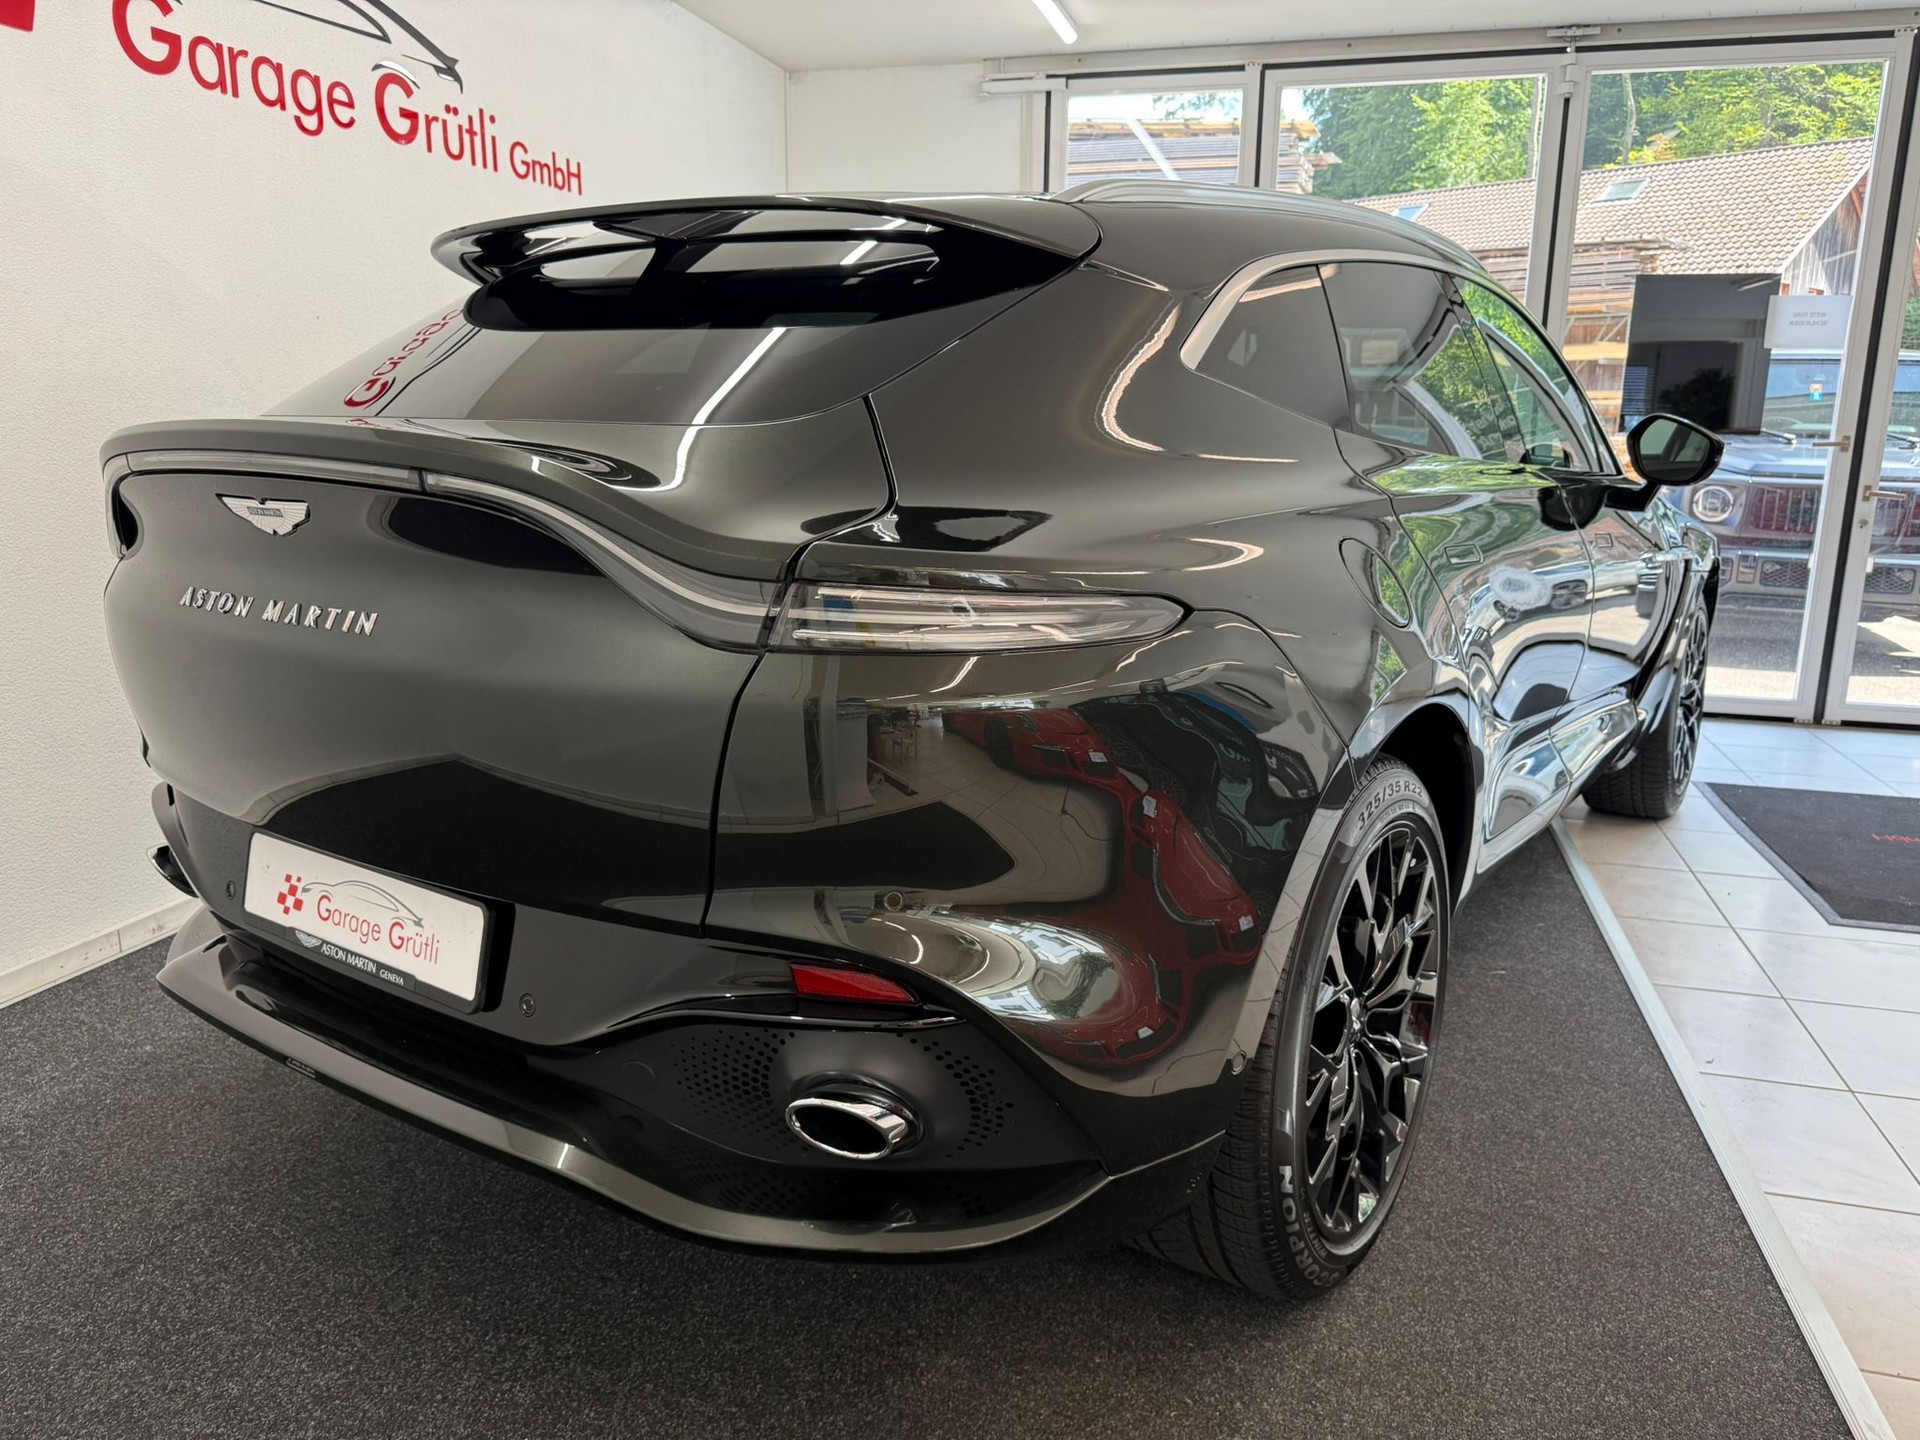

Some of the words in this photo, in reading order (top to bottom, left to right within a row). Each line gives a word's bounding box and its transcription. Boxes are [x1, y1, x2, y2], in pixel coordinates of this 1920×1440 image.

[111, 0, 356, 137] Garage
[374, 72, 499, 173] Grütli
[509, 141, 583, 196] GmbH
[179, 586, 255, 619] ASTON
[261, 599, 379, 636] MARTIN
[1357, 780, 1401, 831] 325/35
[1403, 780, 1424, 798] R22
[316, 894, 382, 944] Garage
[388, 921, 441, 965] Grütli
[320, 942, 346, 962] ASTON
[346, 953, 377, 974] MARTIN
[379, 968, 405, 986] GENEVA
